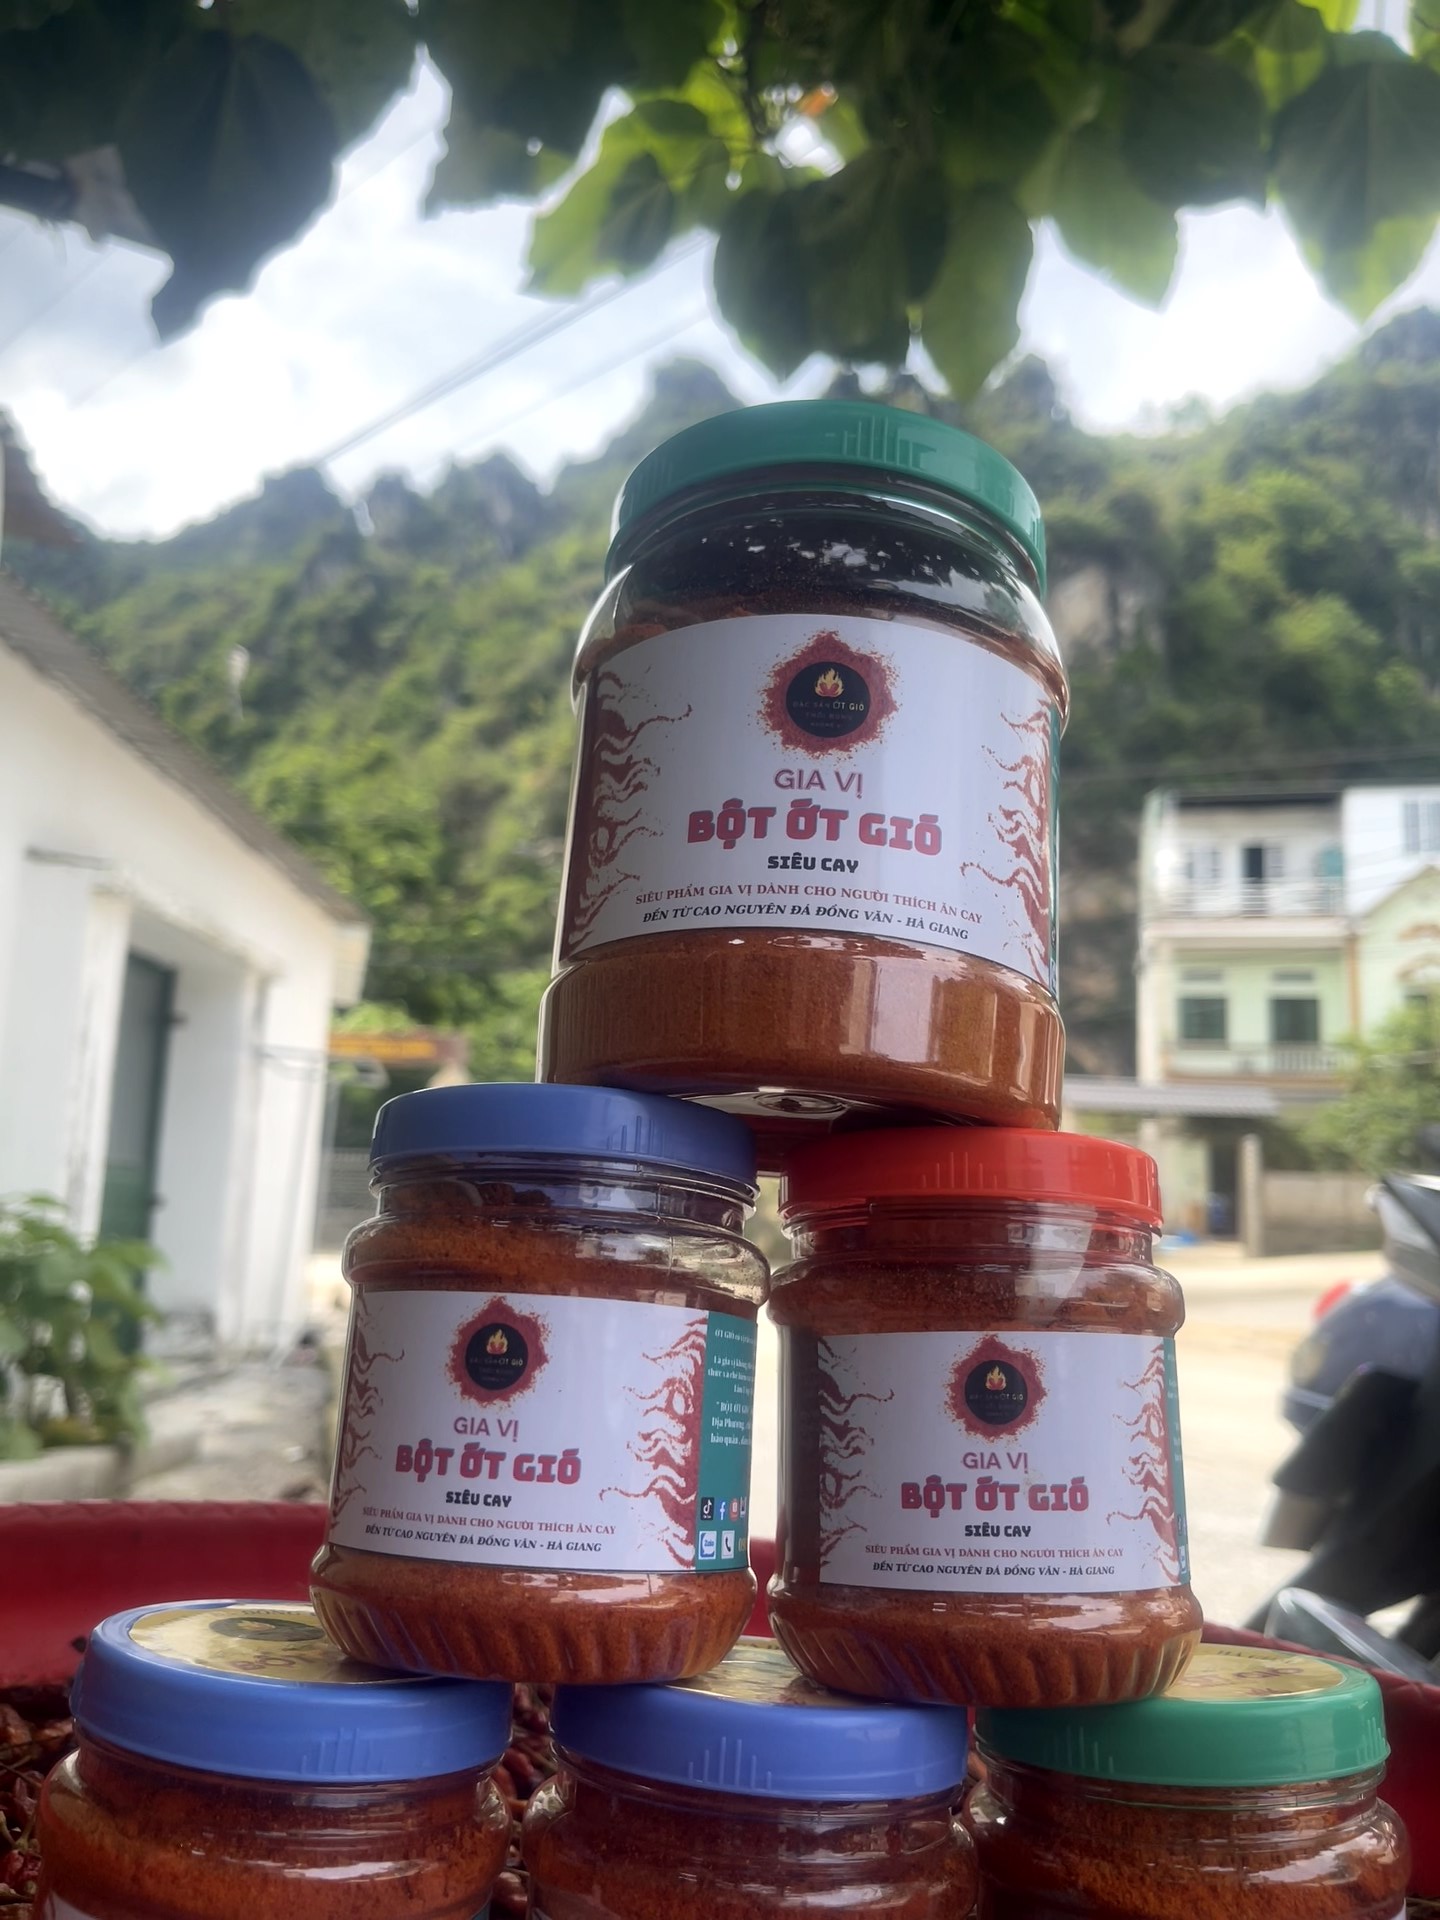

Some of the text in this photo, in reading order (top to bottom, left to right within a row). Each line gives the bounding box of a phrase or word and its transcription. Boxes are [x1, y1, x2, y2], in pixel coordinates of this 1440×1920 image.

[774, 769, 863, 799] GIA VỊ
[688, 797, 942, 856] BỘT ỚT GIÓ
[767, 852, 859, 873] SIÊU CAY
[635, 890, 663, 905] SIÊU
[708, 885, 733, 896] GIA
[737, 884, 752, 897] VỊ
[757, 882, 799, 895] DÀNH
[803, 885, 836, 897] CHO
[840, 887, 889, 902] NGƯỜI
[893, 894, 936, 912] THÍCH
[940, 902, 958, 917] ĂN
[960, 908, 983, 924] CAY
[642, 906, 669, 923] ĐẾN
[693, 905, 721, 916] CAO
[724, 902, 787, 915] NGUYÊN
[790, 904, 812, 916] ĐÁ
[815, 904, 859, 919] ĐỒNG
[864, 909, 894, 923] VĂN
[905, 916, 925, 929] HÀ
[929, 921, 969, 940] GIANG
[454, 1416, 519, 1442] GIA VỊ
[395, 1438, 581, 1485] BỘT ỚT GIÓ
[962, 1452, 1028, 1474] GIA VỊ
[446, 1489, 512, 1508] SIÊU CAY
[901, 1474, 1089, 1518] BỘT ỚT GIÓ
[406, 1511, 422, 1522] GIA
[424, 1513, 436, 1525] VỊ
[437, 1514, 466, 1526] DÀNH
[470, 1517, 494, 1528] CHO
[496, 1519, 533, 1531] NGƯỜI
[537, 1522, 574, 1533] THÍCH
[595, 1525, 616, 1535] CAY
[964, 1522, 1031, 1537] SIÊU CAY
[365, 1523, 381, 1535] ĐẾN
[395, 1528, 414, 1539] CAO
[415, 1531, 457, 1543] NGUYÊN
[459, 1533, 475, 1545] ĐÁ
[514, 1537, 537, 1549] VĂN
[546, 1540, 563, 1551] HÀ
[566, 1542, 602, 1552] GIANG
[865, 1543, 887, 1554] SIÊU
[922, 1547, 941, 1557] GIA
[944, 1548, 955, 1559] VỊ
[959, 1547, 990, 1558] DÀNH
[993, 1549, 1018, 1559] CHO
[1020, 1547, 1056, 1559] NGƯỜI
[1058, 1547, 1090, 1558] THÍCH
[1107, 1548, 1124, 1557] CAY
[872, 1560, 894, 1572] ĐẾN
[912, 1564, 934, 1574] CAO
[936, 1564, 982, 1576] NGUYÊN
[985, 1564, 1000, 1576] ĐÁ
[1038, 1565, 1061, 1576] VĂN
[1069, 1565, 1083, 1576] HÀ
[1085, 1566, 1115, 1575] GIANG
